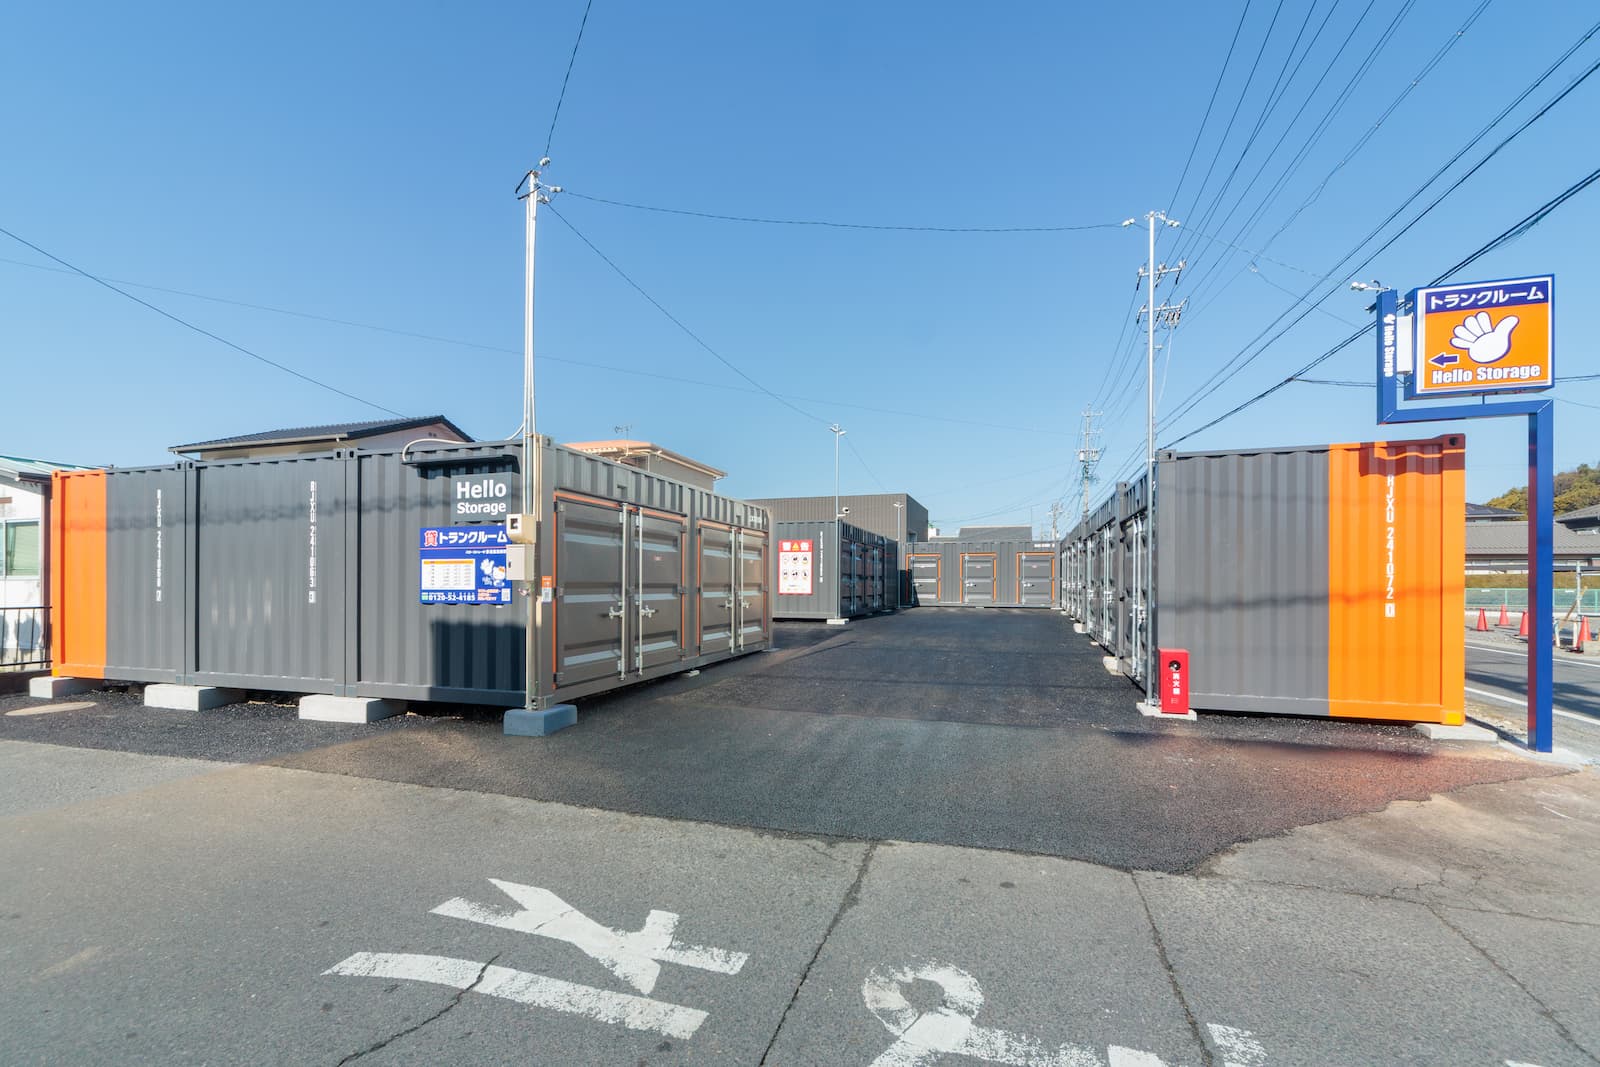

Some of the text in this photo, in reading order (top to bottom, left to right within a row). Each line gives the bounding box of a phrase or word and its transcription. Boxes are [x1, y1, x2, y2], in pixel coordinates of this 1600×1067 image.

[1430, 286, 1544, 310] トランクルーム
[1384, 325, 1395, 346] Hello
[1432, 365, 1541, 385] Hello Storage
[457, 480, 507, 499] Hello
[457, 502, 507, 515] Storage
[1386, 527, 1395, 599] 241072
